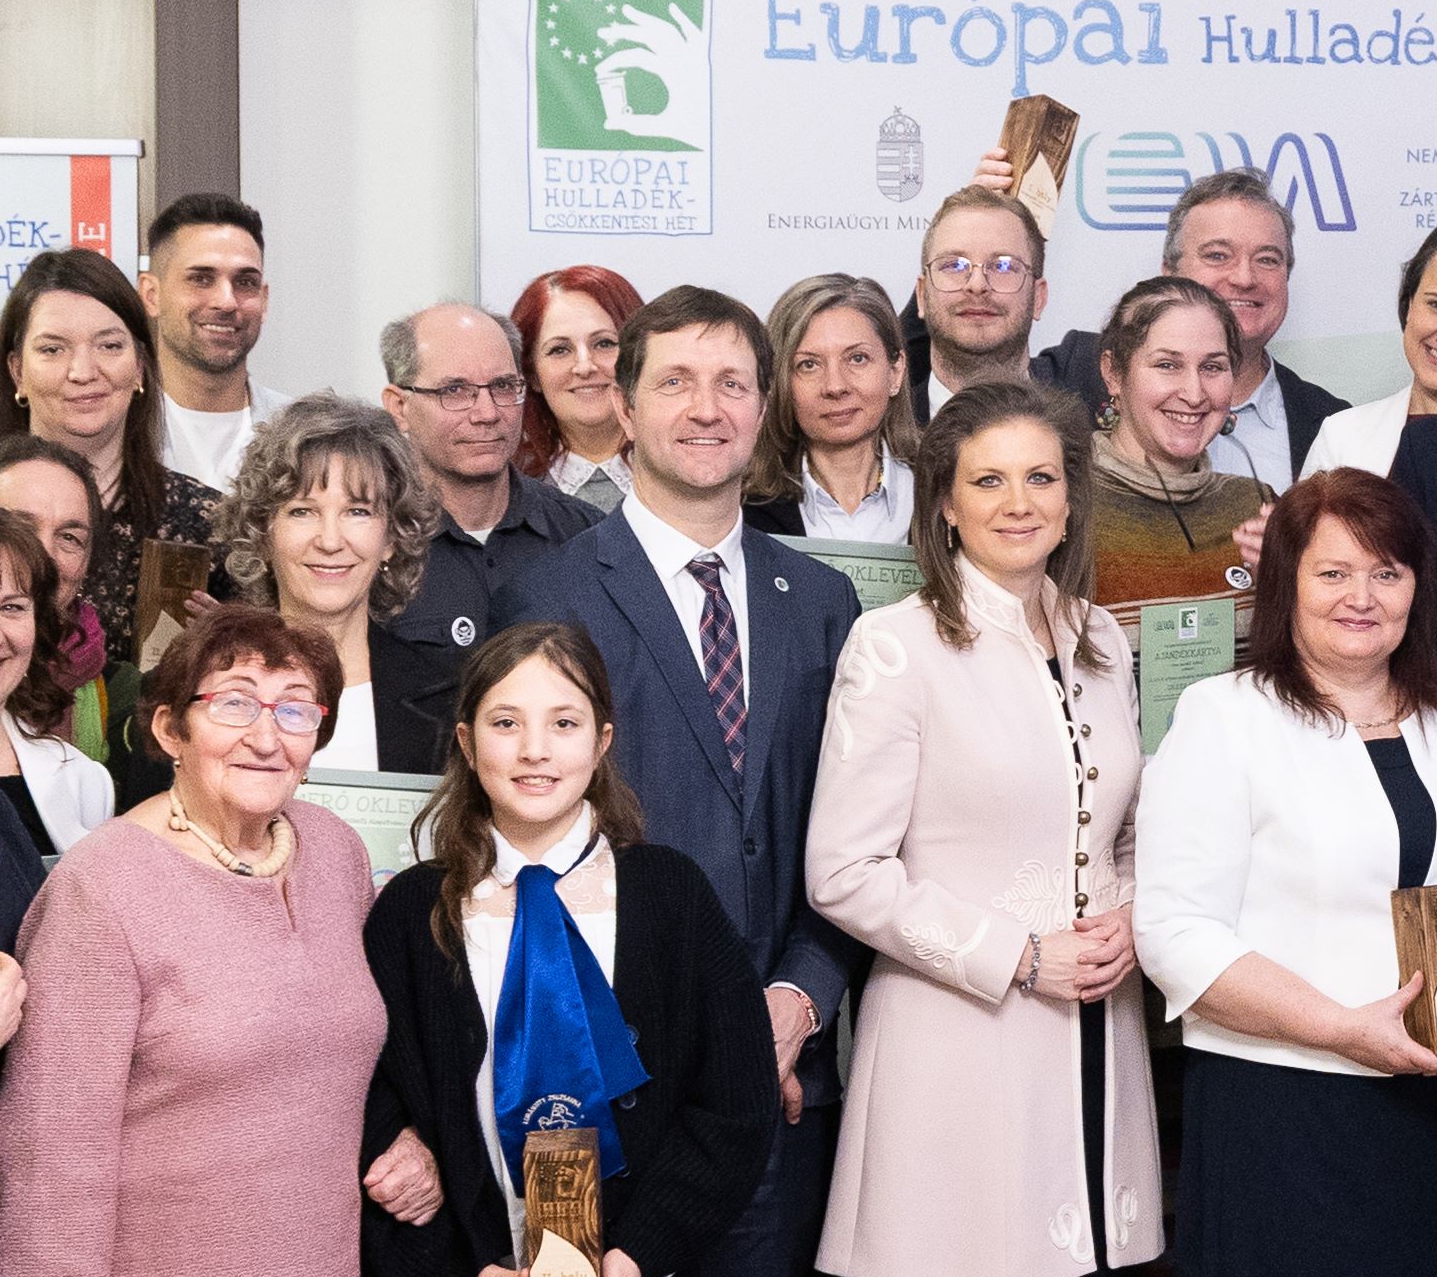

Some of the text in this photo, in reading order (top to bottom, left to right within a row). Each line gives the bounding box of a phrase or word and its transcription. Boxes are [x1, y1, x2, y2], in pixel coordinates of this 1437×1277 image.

[544, 151, 690, 185] EURÓPAI
[544, 184, 696, 210] HULLADÉK-
[545, 211, 697, 230] CSÖKKENTÉSI HÉT
